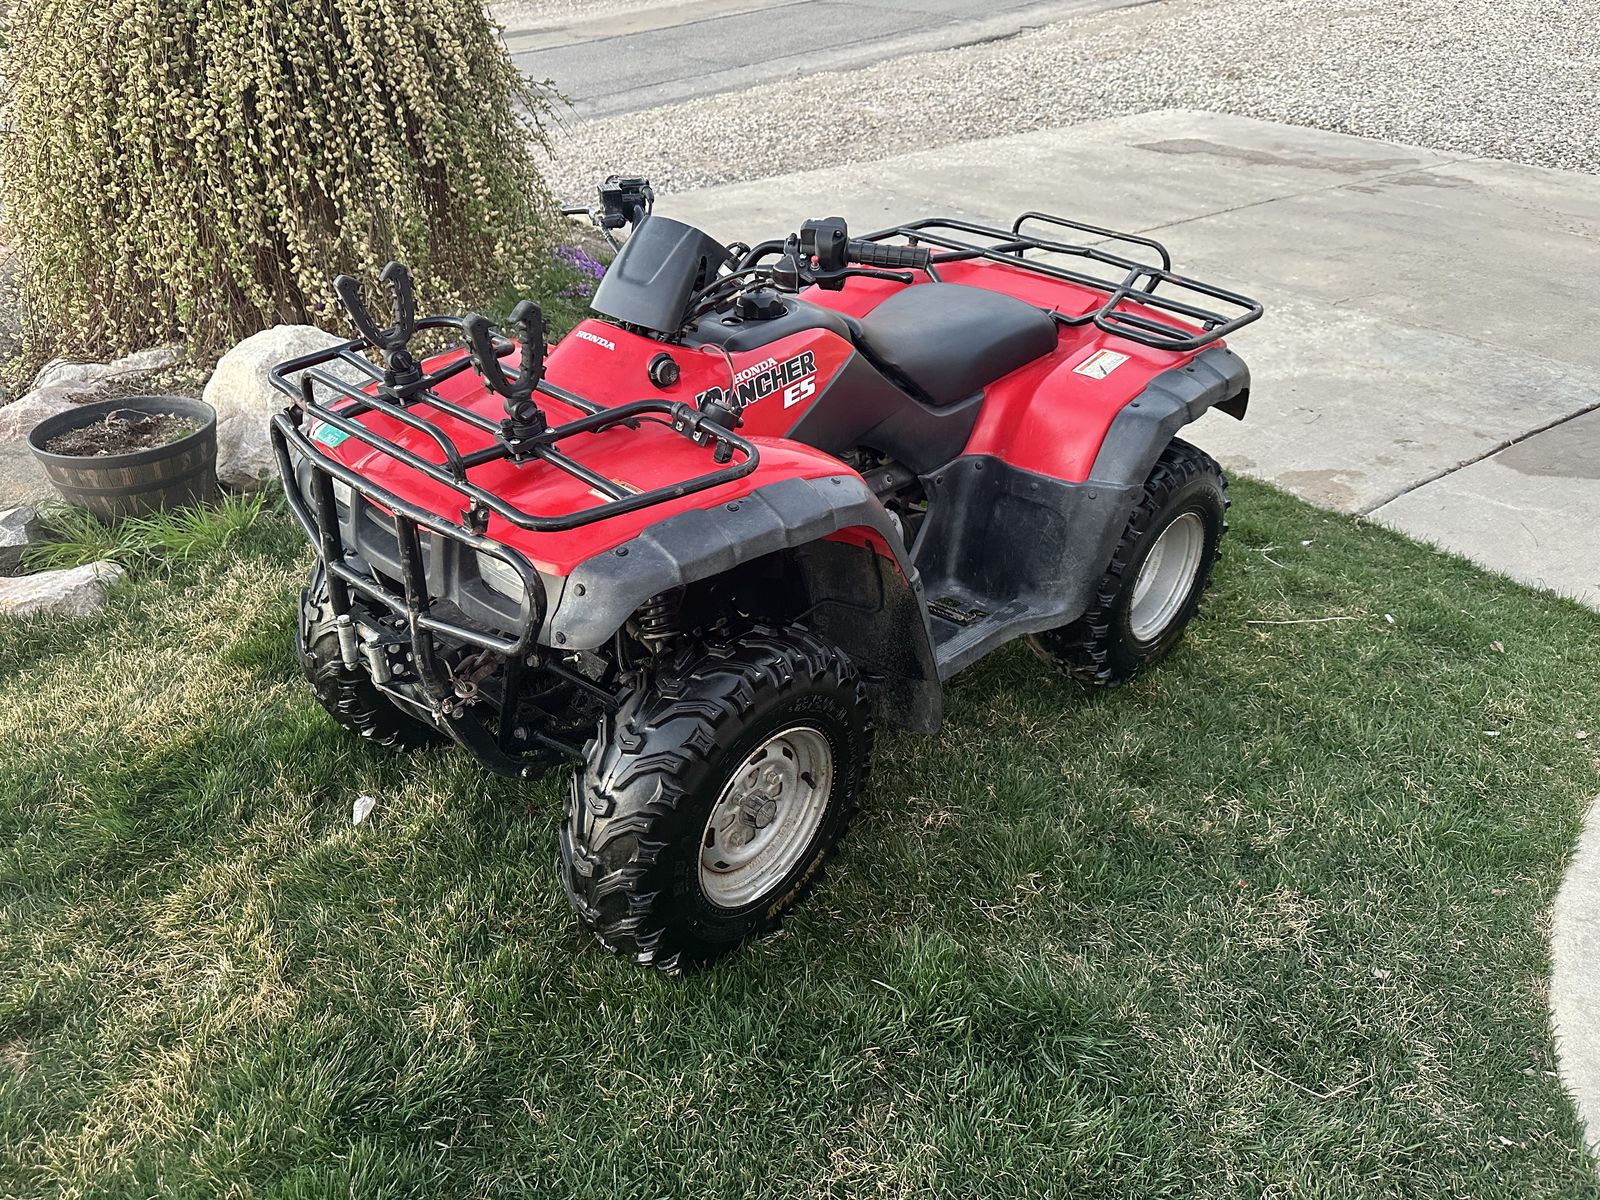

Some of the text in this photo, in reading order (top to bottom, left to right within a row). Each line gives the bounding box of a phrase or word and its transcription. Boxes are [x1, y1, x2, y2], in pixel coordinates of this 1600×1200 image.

[576, 330, 615, 351] HONDA
[735, 357, 778, 383] HONDA
[783, 375, 816, 409] ES
